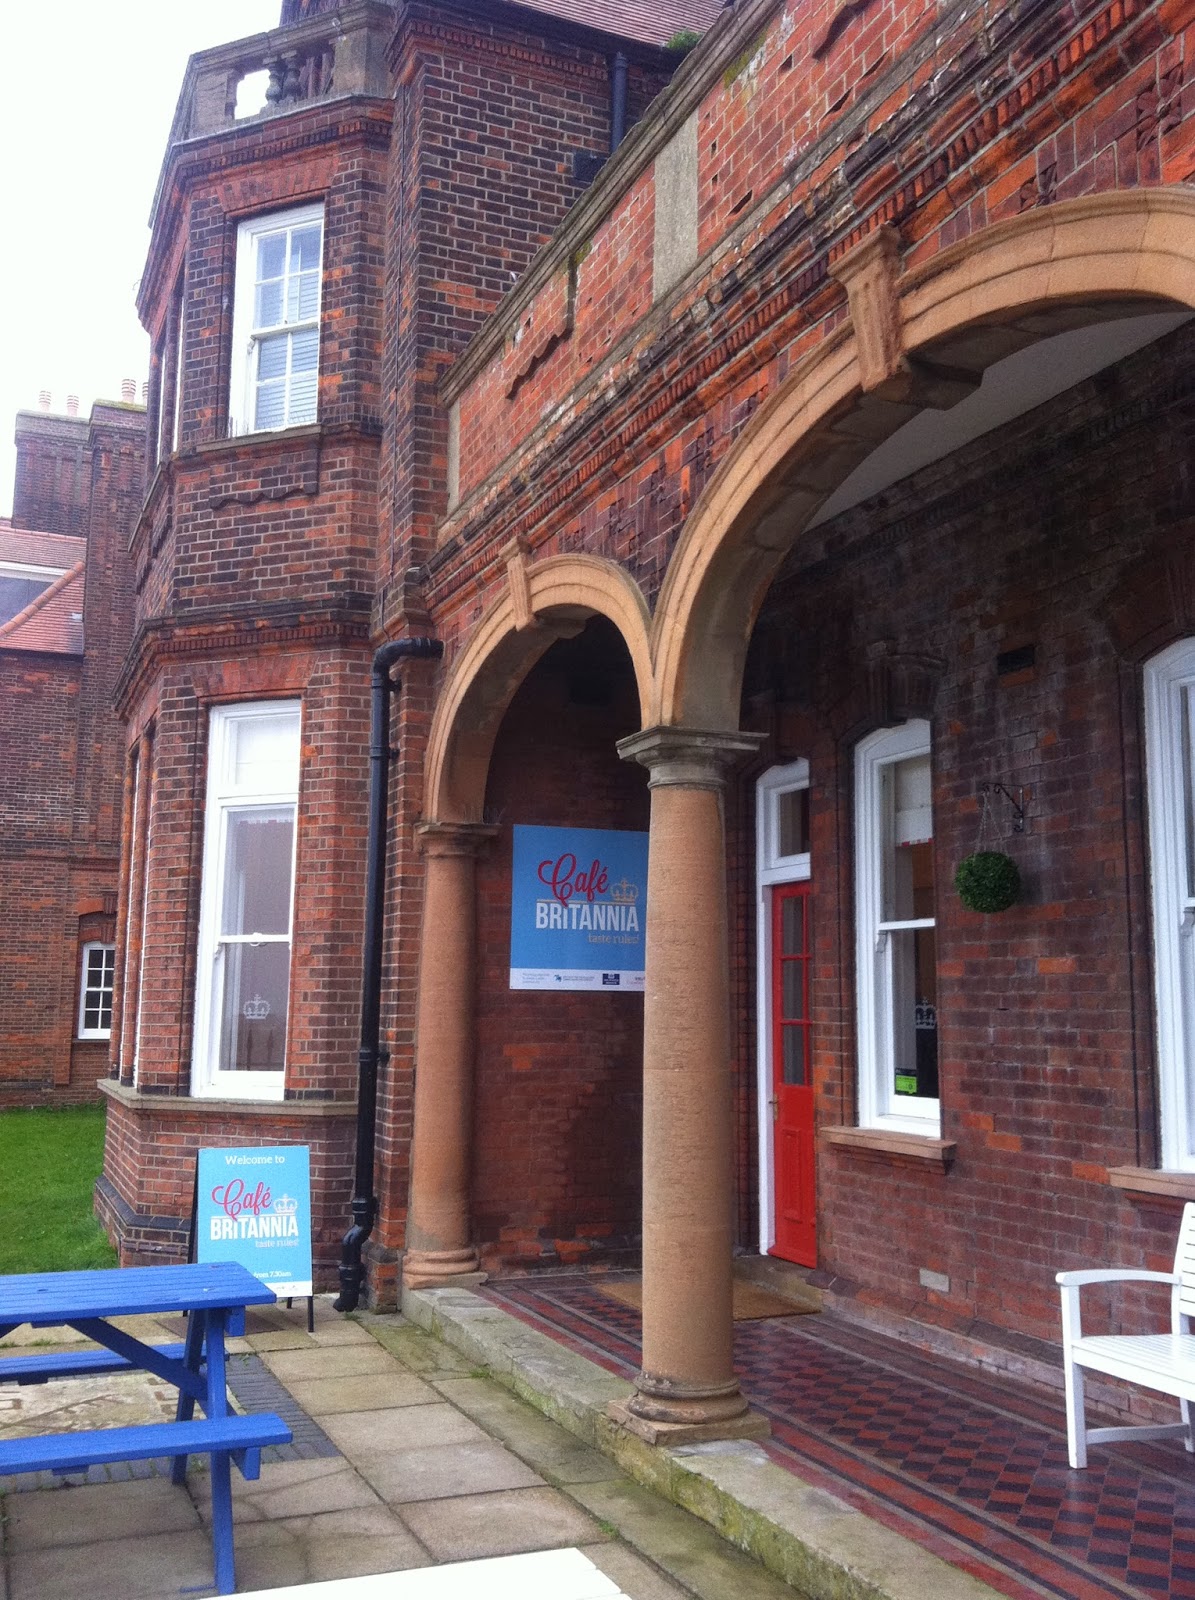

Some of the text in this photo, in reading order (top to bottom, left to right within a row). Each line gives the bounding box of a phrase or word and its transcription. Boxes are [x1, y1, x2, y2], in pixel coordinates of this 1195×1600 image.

[539, 853, 609, 908] Café
[536, 906, 640, 931] BRITANNIA
[588, 934, 612, 944] taste
[225, 1155, 285, 1165] Welcome to
[212, 1178, 272, 1221] Café
[211, 1216, 298, 1240] BRITANNIA
[255, 1239, 275, 1248] taste
